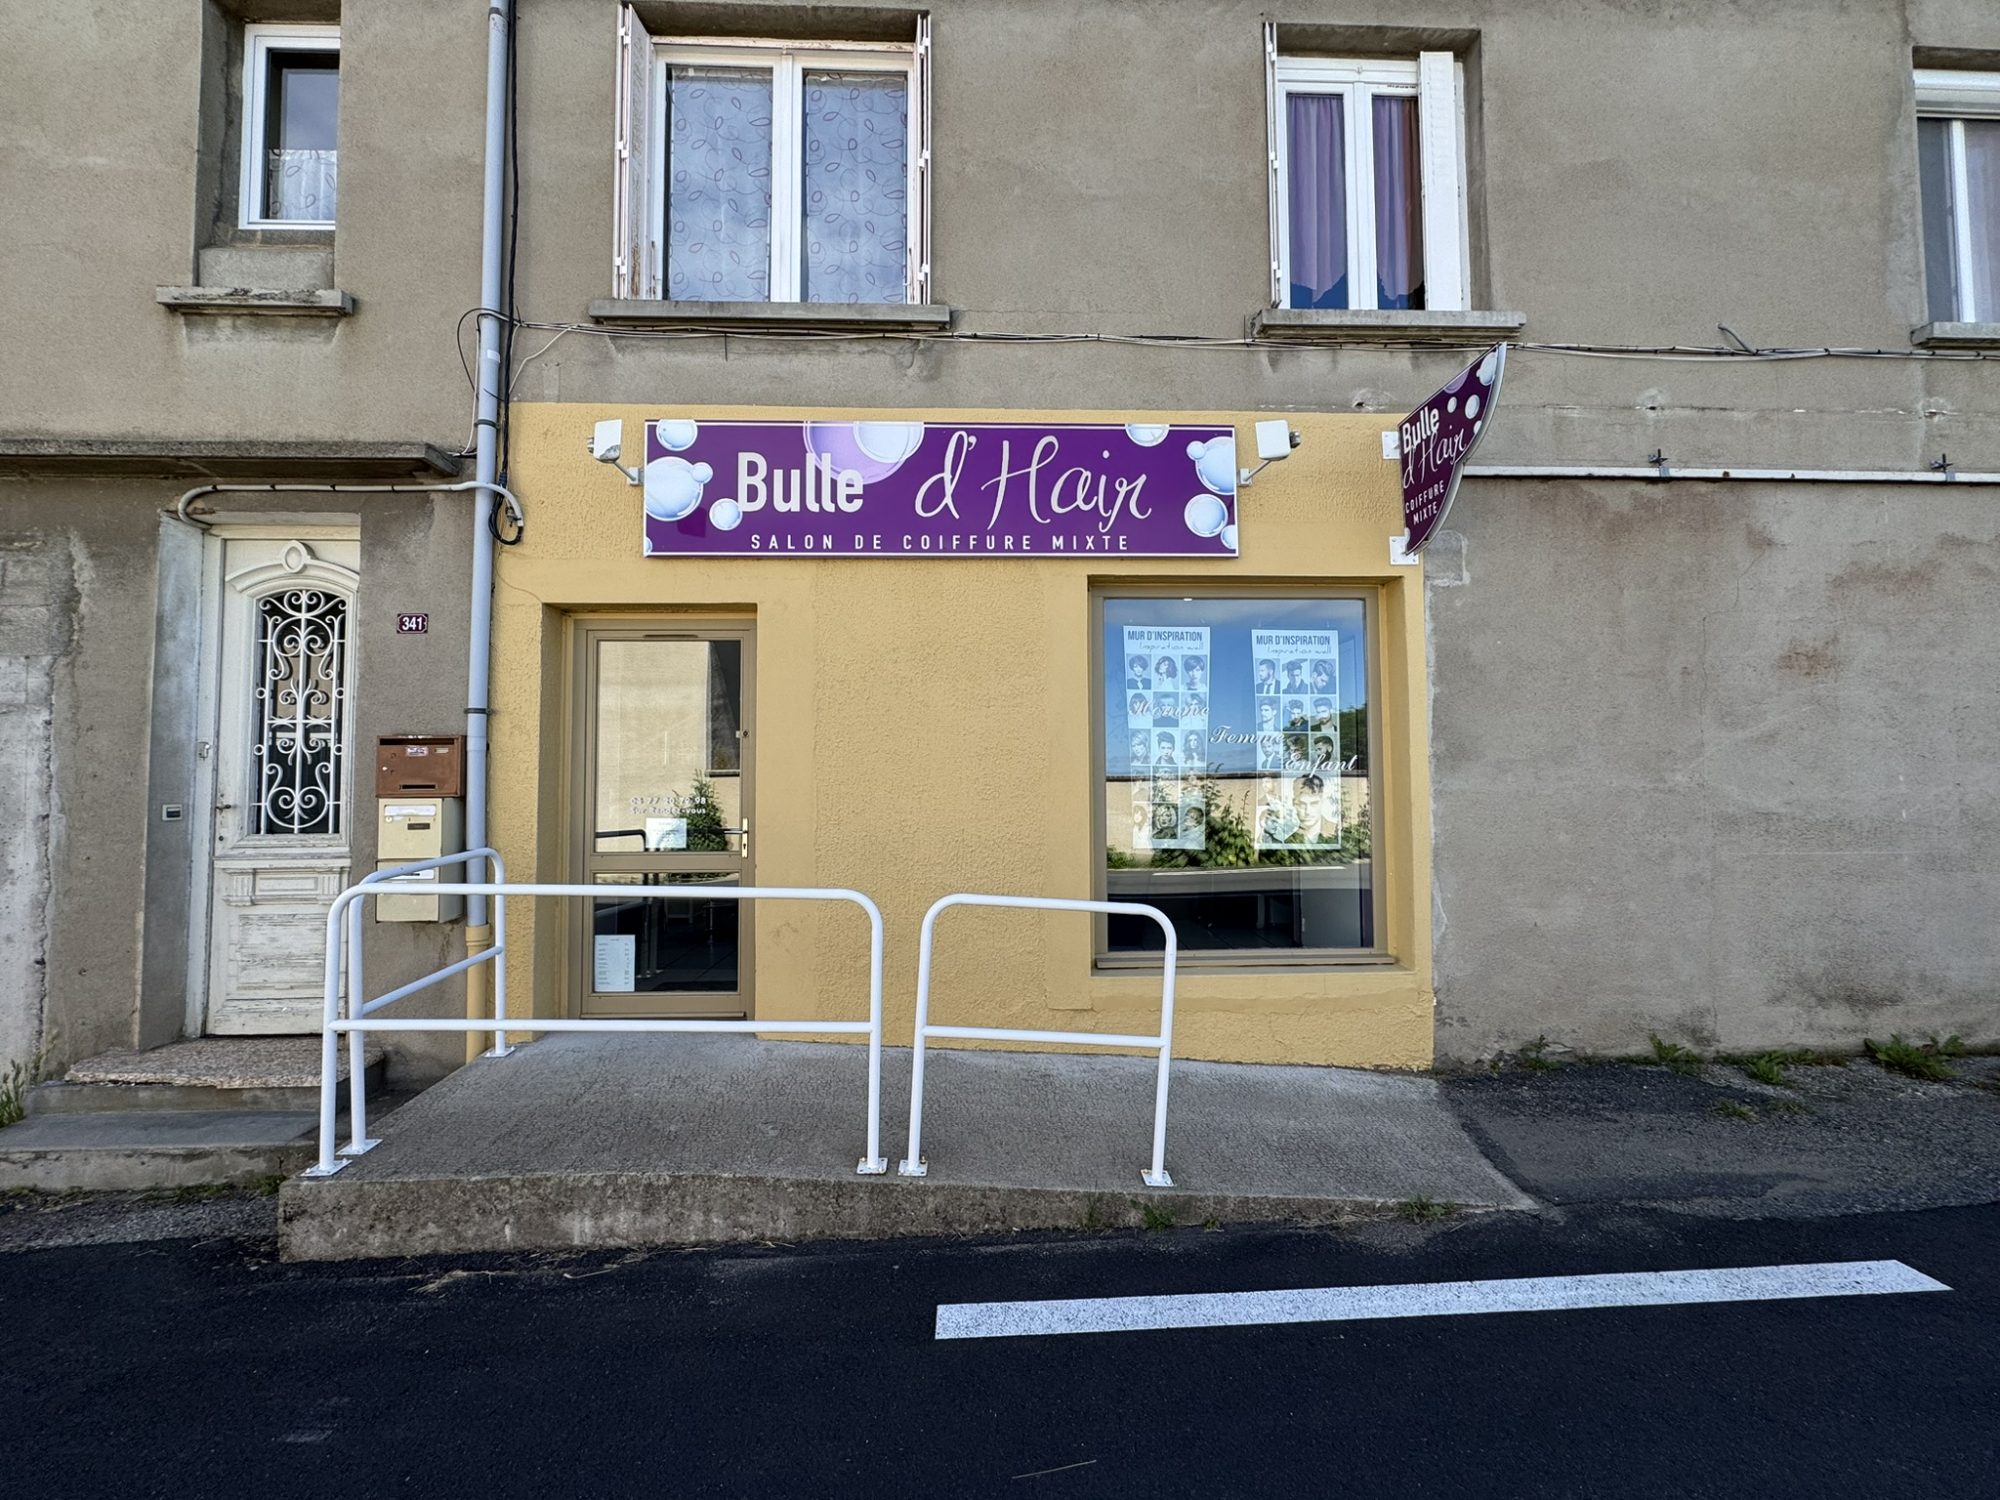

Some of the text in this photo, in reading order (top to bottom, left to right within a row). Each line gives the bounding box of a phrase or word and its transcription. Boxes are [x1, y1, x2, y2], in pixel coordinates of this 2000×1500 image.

[1402, 406, 1440, 454] Bulle
[738, 430, 1152, 532] Bulle d'Hair
[1405, 480, 1445, 513] COIFFURE
[1413, 501, 1437, 525] MIXTE
[751, 534, 1129, 551] SALON DE COIFFURE MIXTE
[402, 617, 423, 630] 341
[1127, 630, 1203, 642] MUR D'INSPIRATION
[1256, 635, 1331, 646] MUR D'INSPIRATION
[1209, 724, 1286, 744] Femme
[1284, 752, 1358, 778] Enfant
